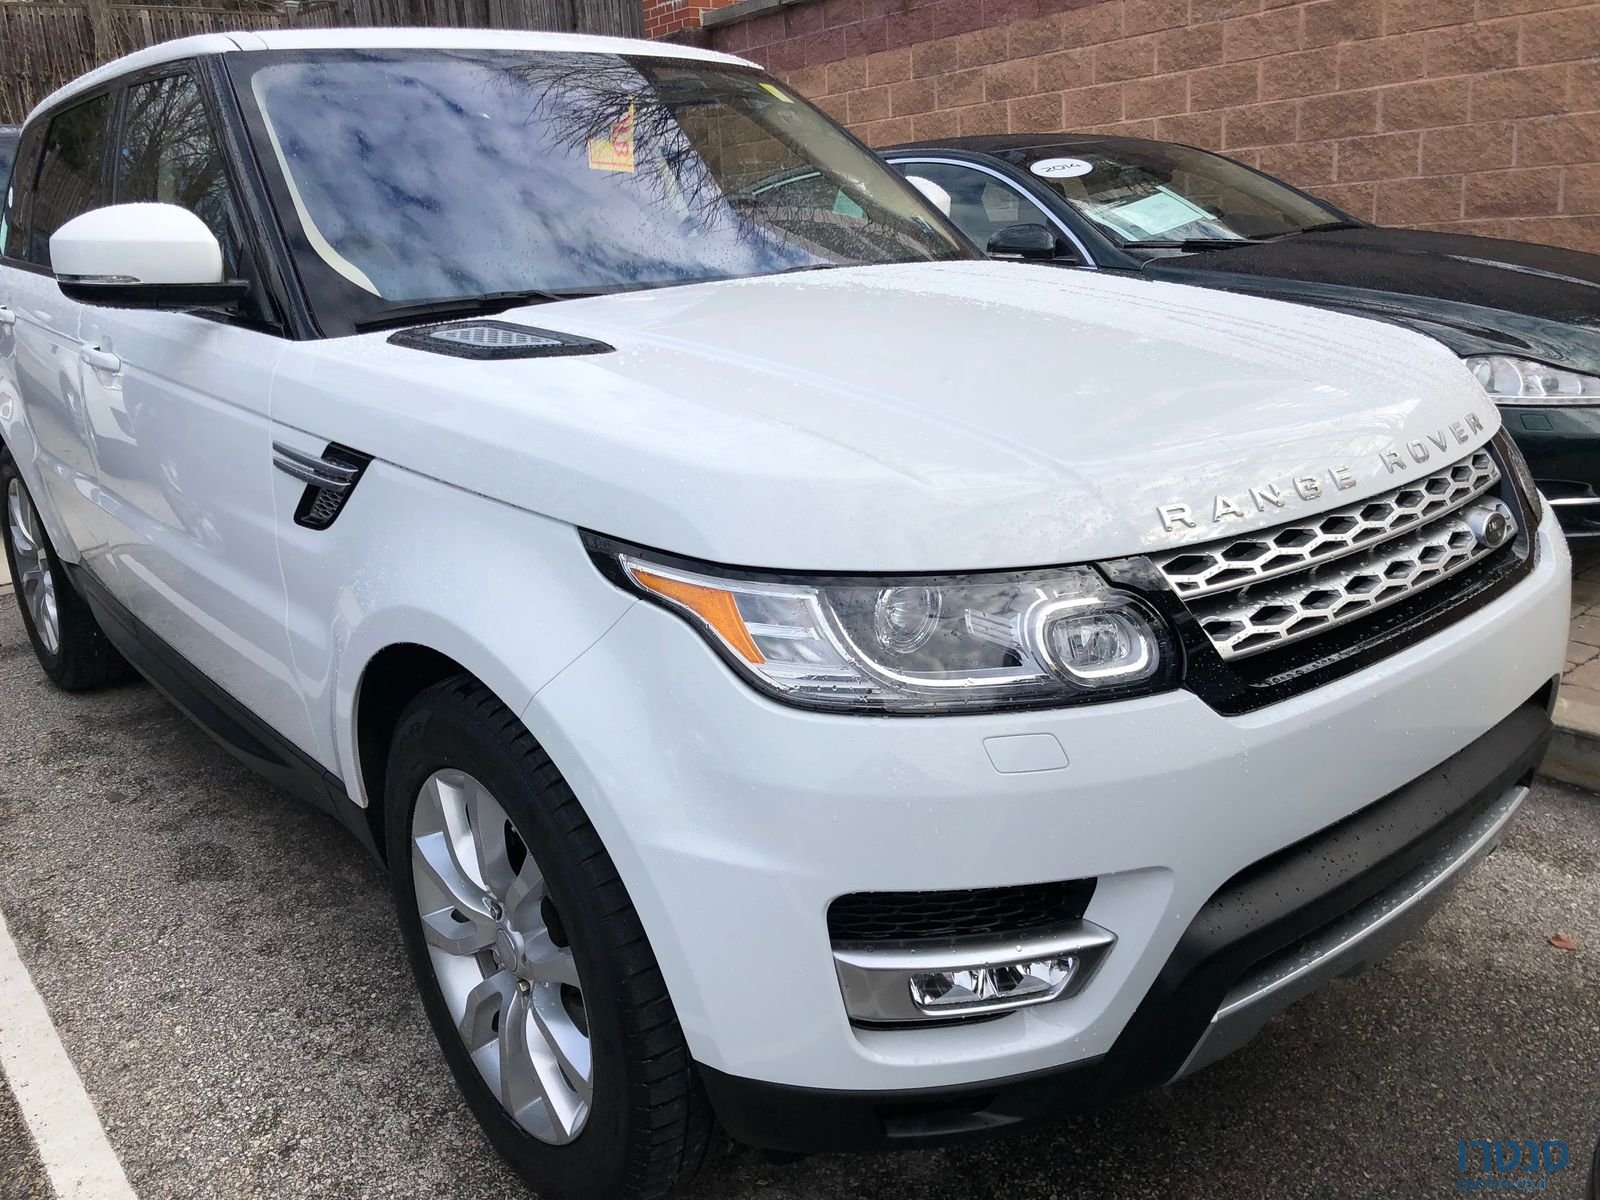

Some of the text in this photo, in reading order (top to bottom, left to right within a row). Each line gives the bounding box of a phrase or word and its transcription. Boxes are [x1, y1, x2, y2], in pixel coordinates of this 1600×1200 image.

[1041, 163, 1081, 172] 2014
[1156, 412, 1485, 532] RANGE ROVER
